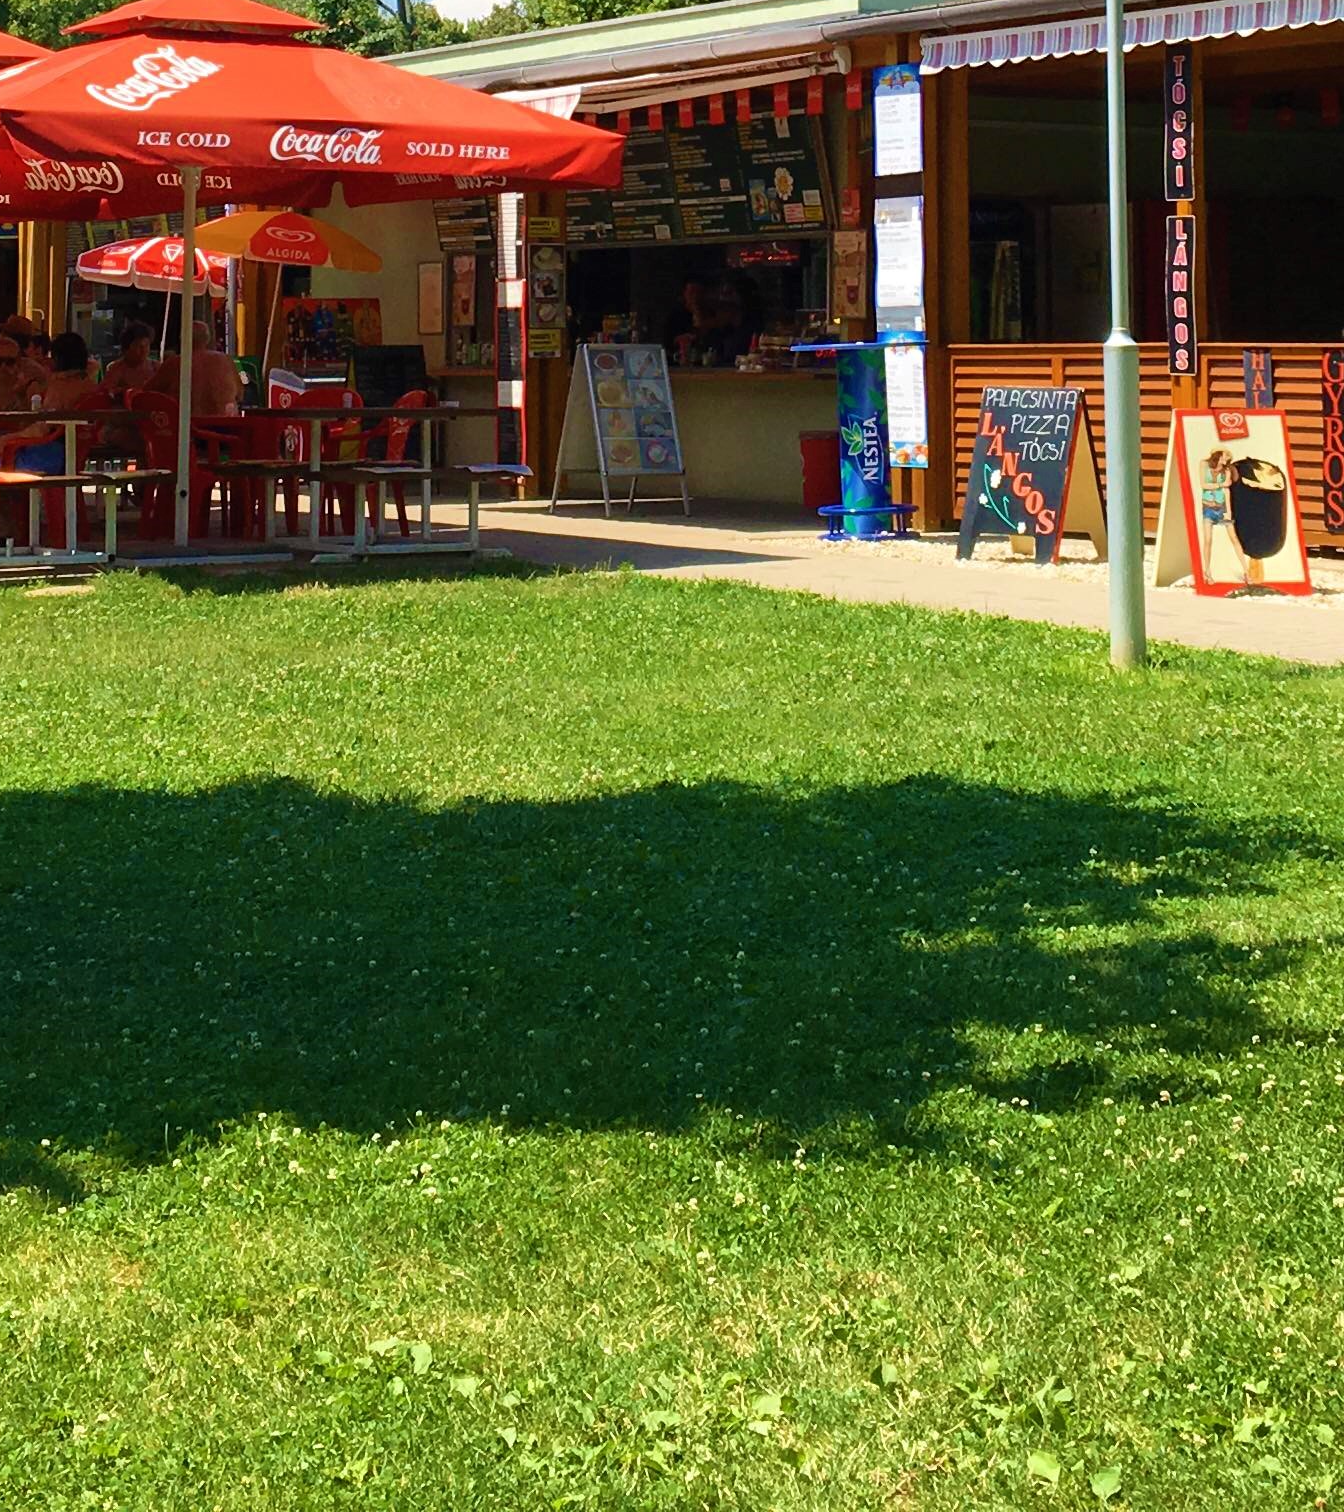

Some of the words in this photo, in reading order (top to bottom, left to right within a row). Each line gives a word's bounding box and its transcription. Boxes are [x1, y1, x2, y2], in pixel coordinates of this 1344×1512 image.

[137, 131, 171, 147] ICE
[176, 131, 231, 148] COLD
[269, 125, 384, 164] Coca-Cola
[406, 141, 454, 158] SOLD
[458, 144, 510, 160] HERE
[265, 248, 312, 261] ALGIDA
[1173, 219, 1189, 371] LÁNGOS
[985, 388, 1078, 410] PALACSINTA
[1011, 414, 1070, 436] PIZZA
[863, 416, 878, 481] NESTEA
[1019, 437, 1066, 461] TÓCSI
